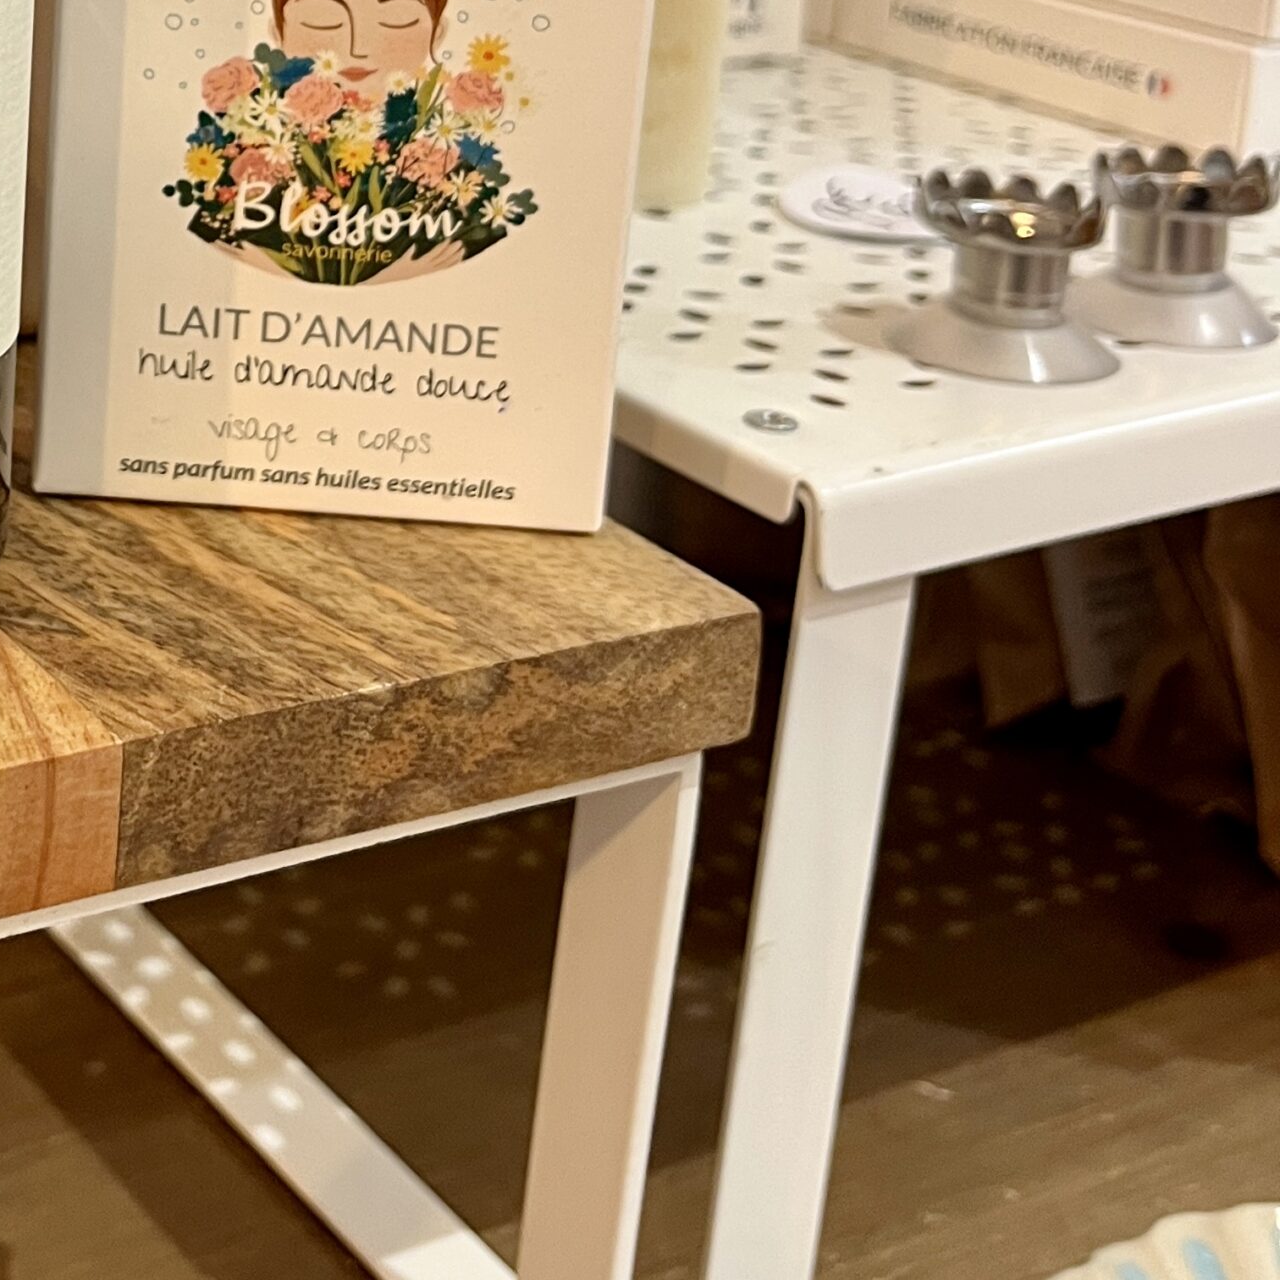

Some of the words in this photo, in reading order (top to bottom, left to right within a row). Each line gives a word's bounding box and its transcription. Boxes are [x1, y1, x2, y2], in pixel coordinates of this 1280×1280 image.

[232, 173, 463, 246] Blossom
[282, 241, 393, 263] savonnerie
[158, 303, 251, 340] LAIT
[138, 348, 214, 381] huile
[234, 355, 396, 395] d'amande
[417, 368, 510, 404] douce
[208, 414, 297, 462] visage
[119, 458, 168, 475] sans
[173, 460, 255, 483] parfum
[260, 468, 310, 486] sans
[315, 468, 382, 491] huiles
[386, 477, 517, 501] essentielles
